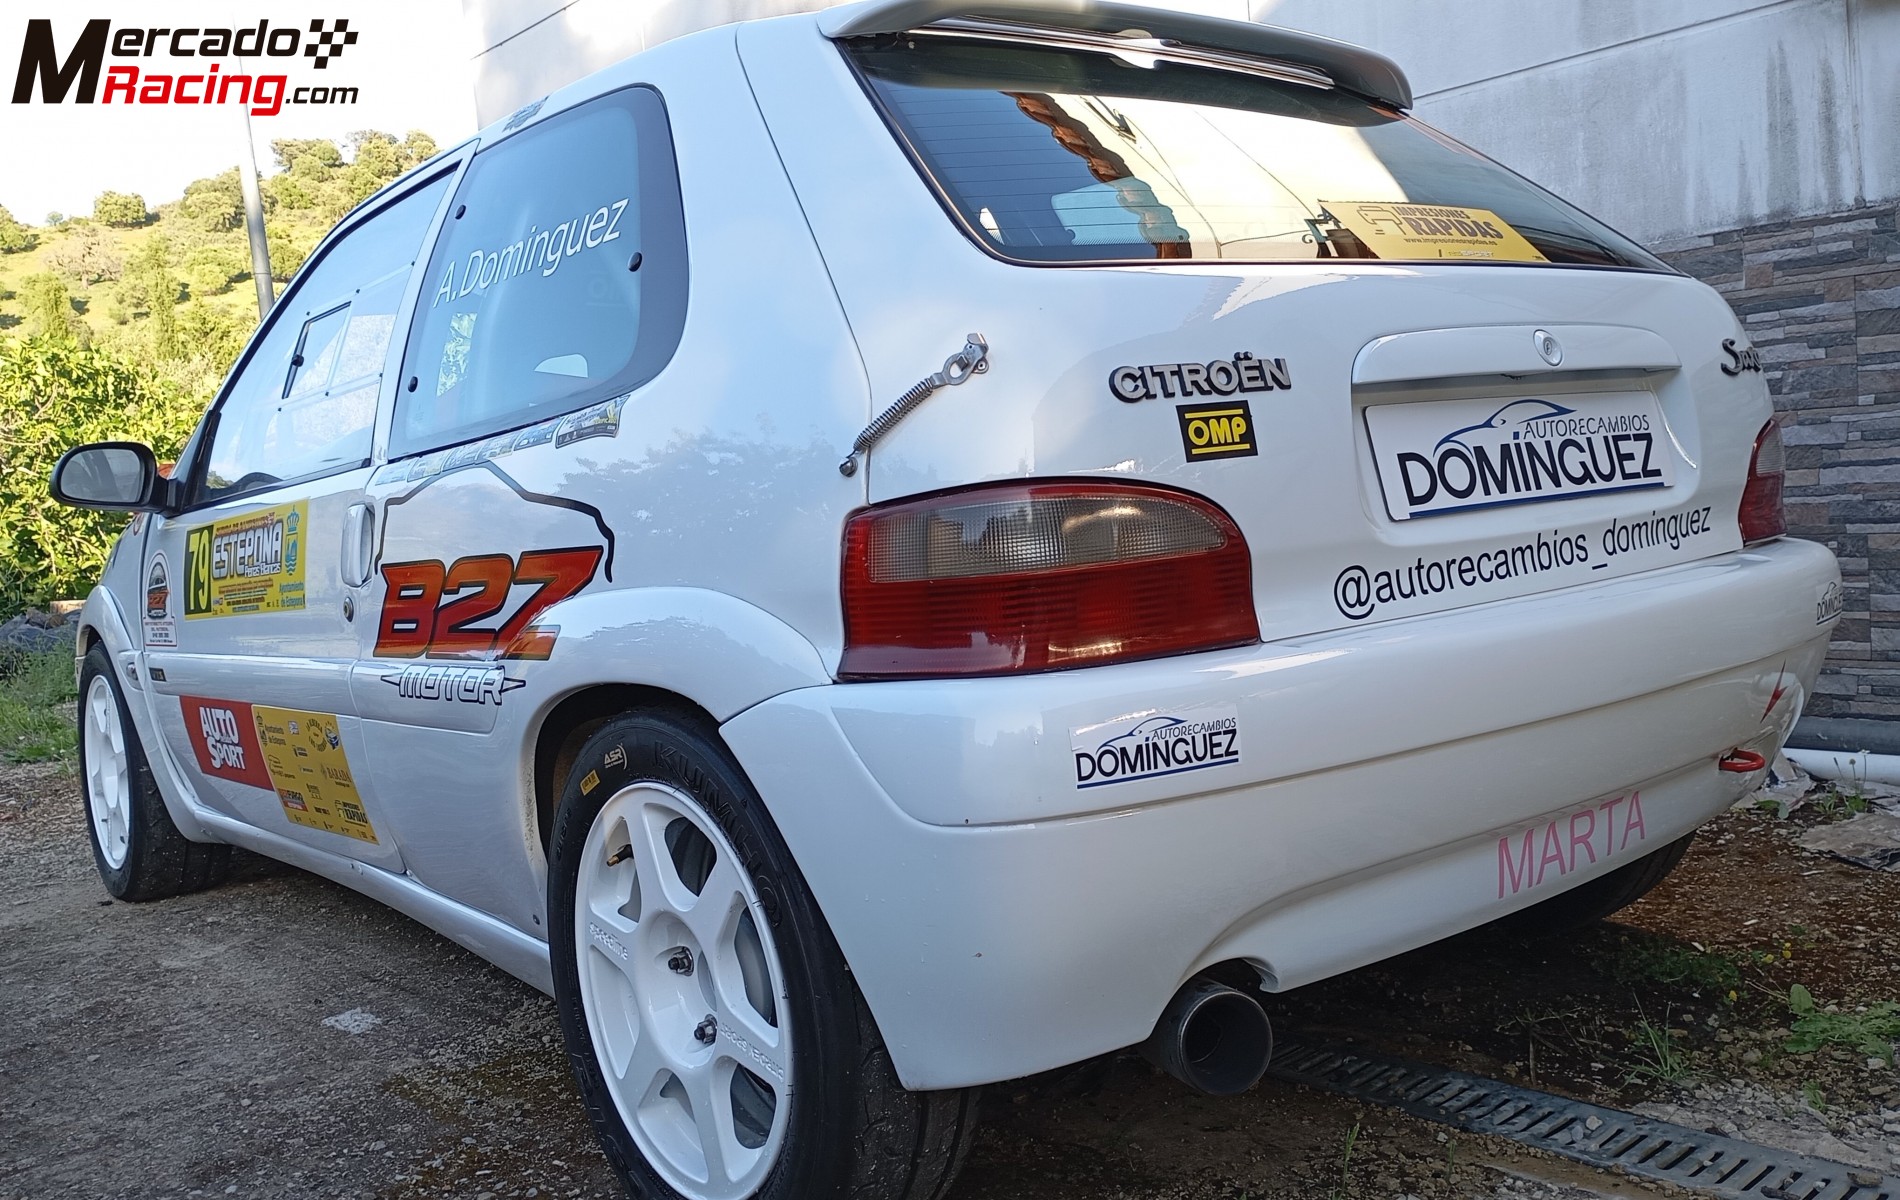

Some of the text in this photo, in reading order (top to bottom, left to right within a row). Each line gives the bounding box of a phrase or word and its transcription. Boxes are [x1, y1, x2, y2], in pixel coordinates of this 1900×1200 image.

[1391, 206, 1471, 219] IMPRESIONES
[1108, 351, 1292, 403] CITROËN
[1188, 416, 1247, 446] OMP
[1523, 414, 1650, 440] AUTORECAMBIOS
[212, 518, 284, 580] ESTEPONA
[188, 529, 211, 611] 79
[373, 545, 604, 661] B27
[399, 664, 505, 705] MOTOR
[198, 706, 239, 744] AUTO
[1151, 717, 1237, 742] AUTORECAMBIOS
[206, 736, 246, 770] SPORT
[604, 748, 623, 764] ASR
[1497, 790, 1647, 899] MARTA
